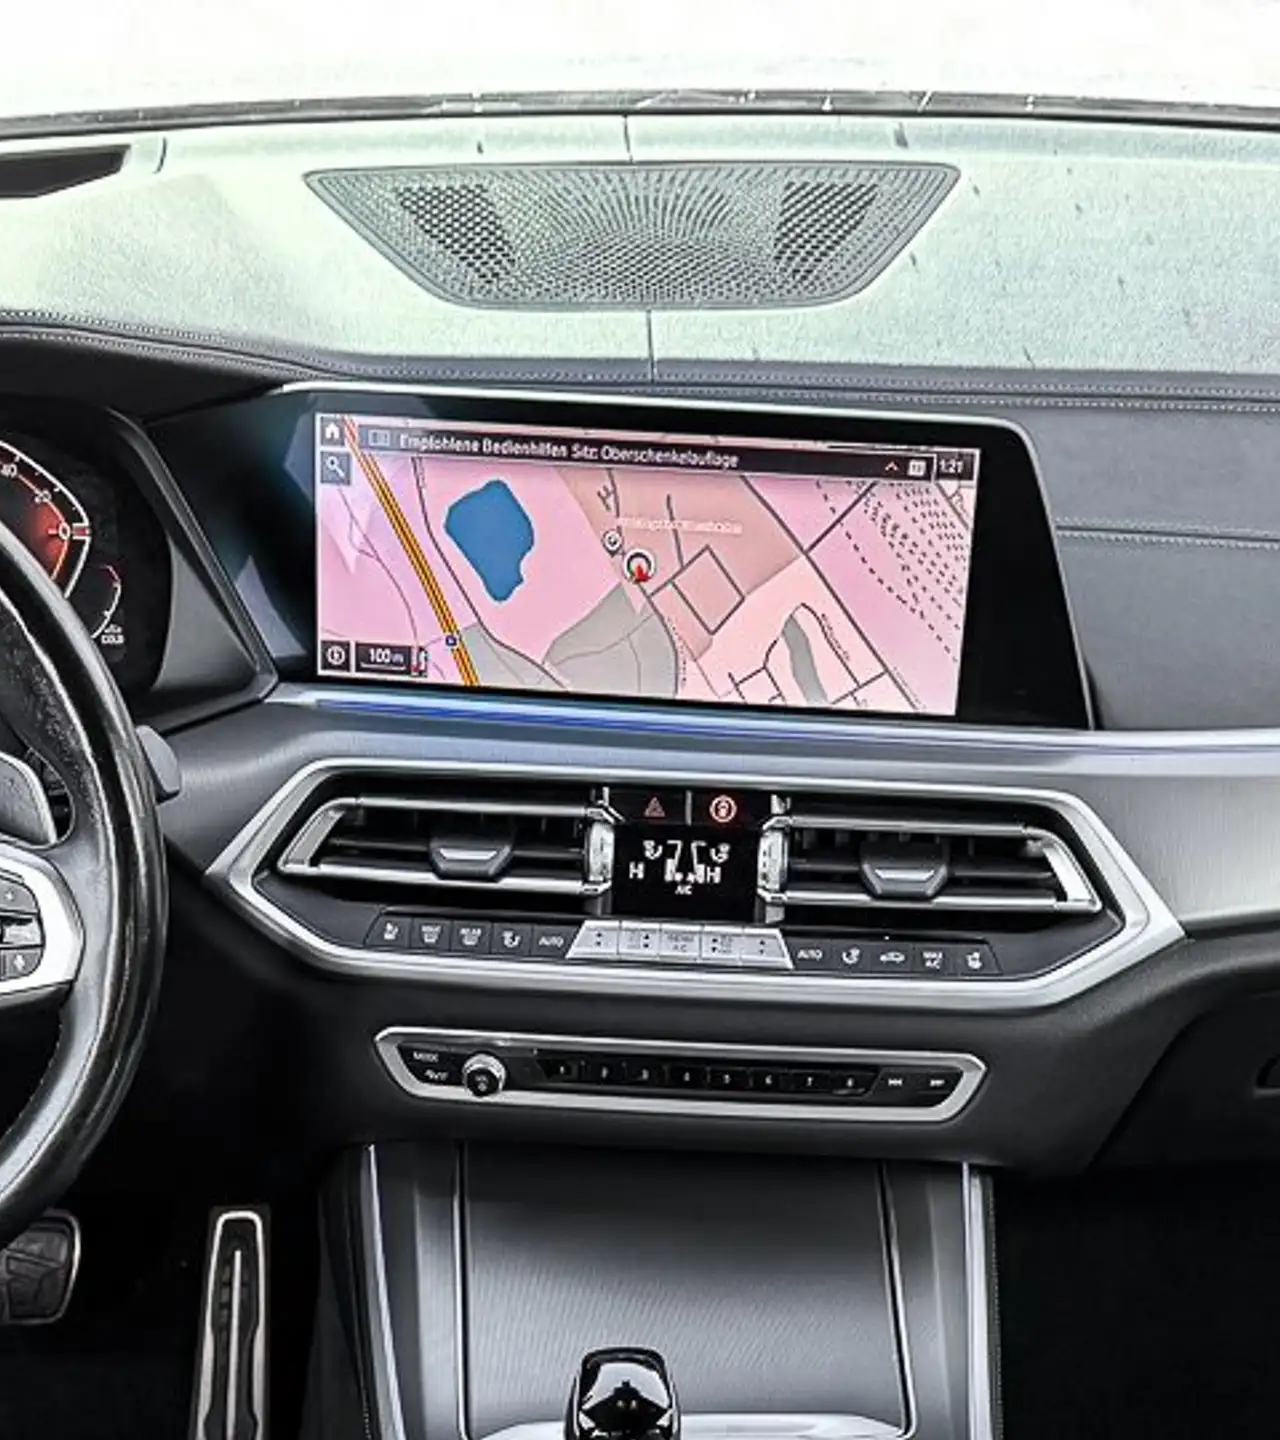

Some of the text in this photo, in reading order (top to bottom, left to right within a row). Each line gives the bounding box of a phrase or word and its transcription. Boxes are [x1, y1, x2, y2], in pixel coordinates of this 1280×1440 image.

[399, 433, 479, 453] Empfohlene
[482, 438, 567, 459] Bedienhilfen
[601, 445, 740, 469] Oberschenkelauflage
[0, 463, 18, 477] 40
[58, 524, 70, 541] 0
[369, 648, 391, 663] 100
[629, 862, 645, 879] H
[706, 866, 721, 884] H
[538, 936, 564, 947] AUTO
[797, 949, 823, 961] AUTO
